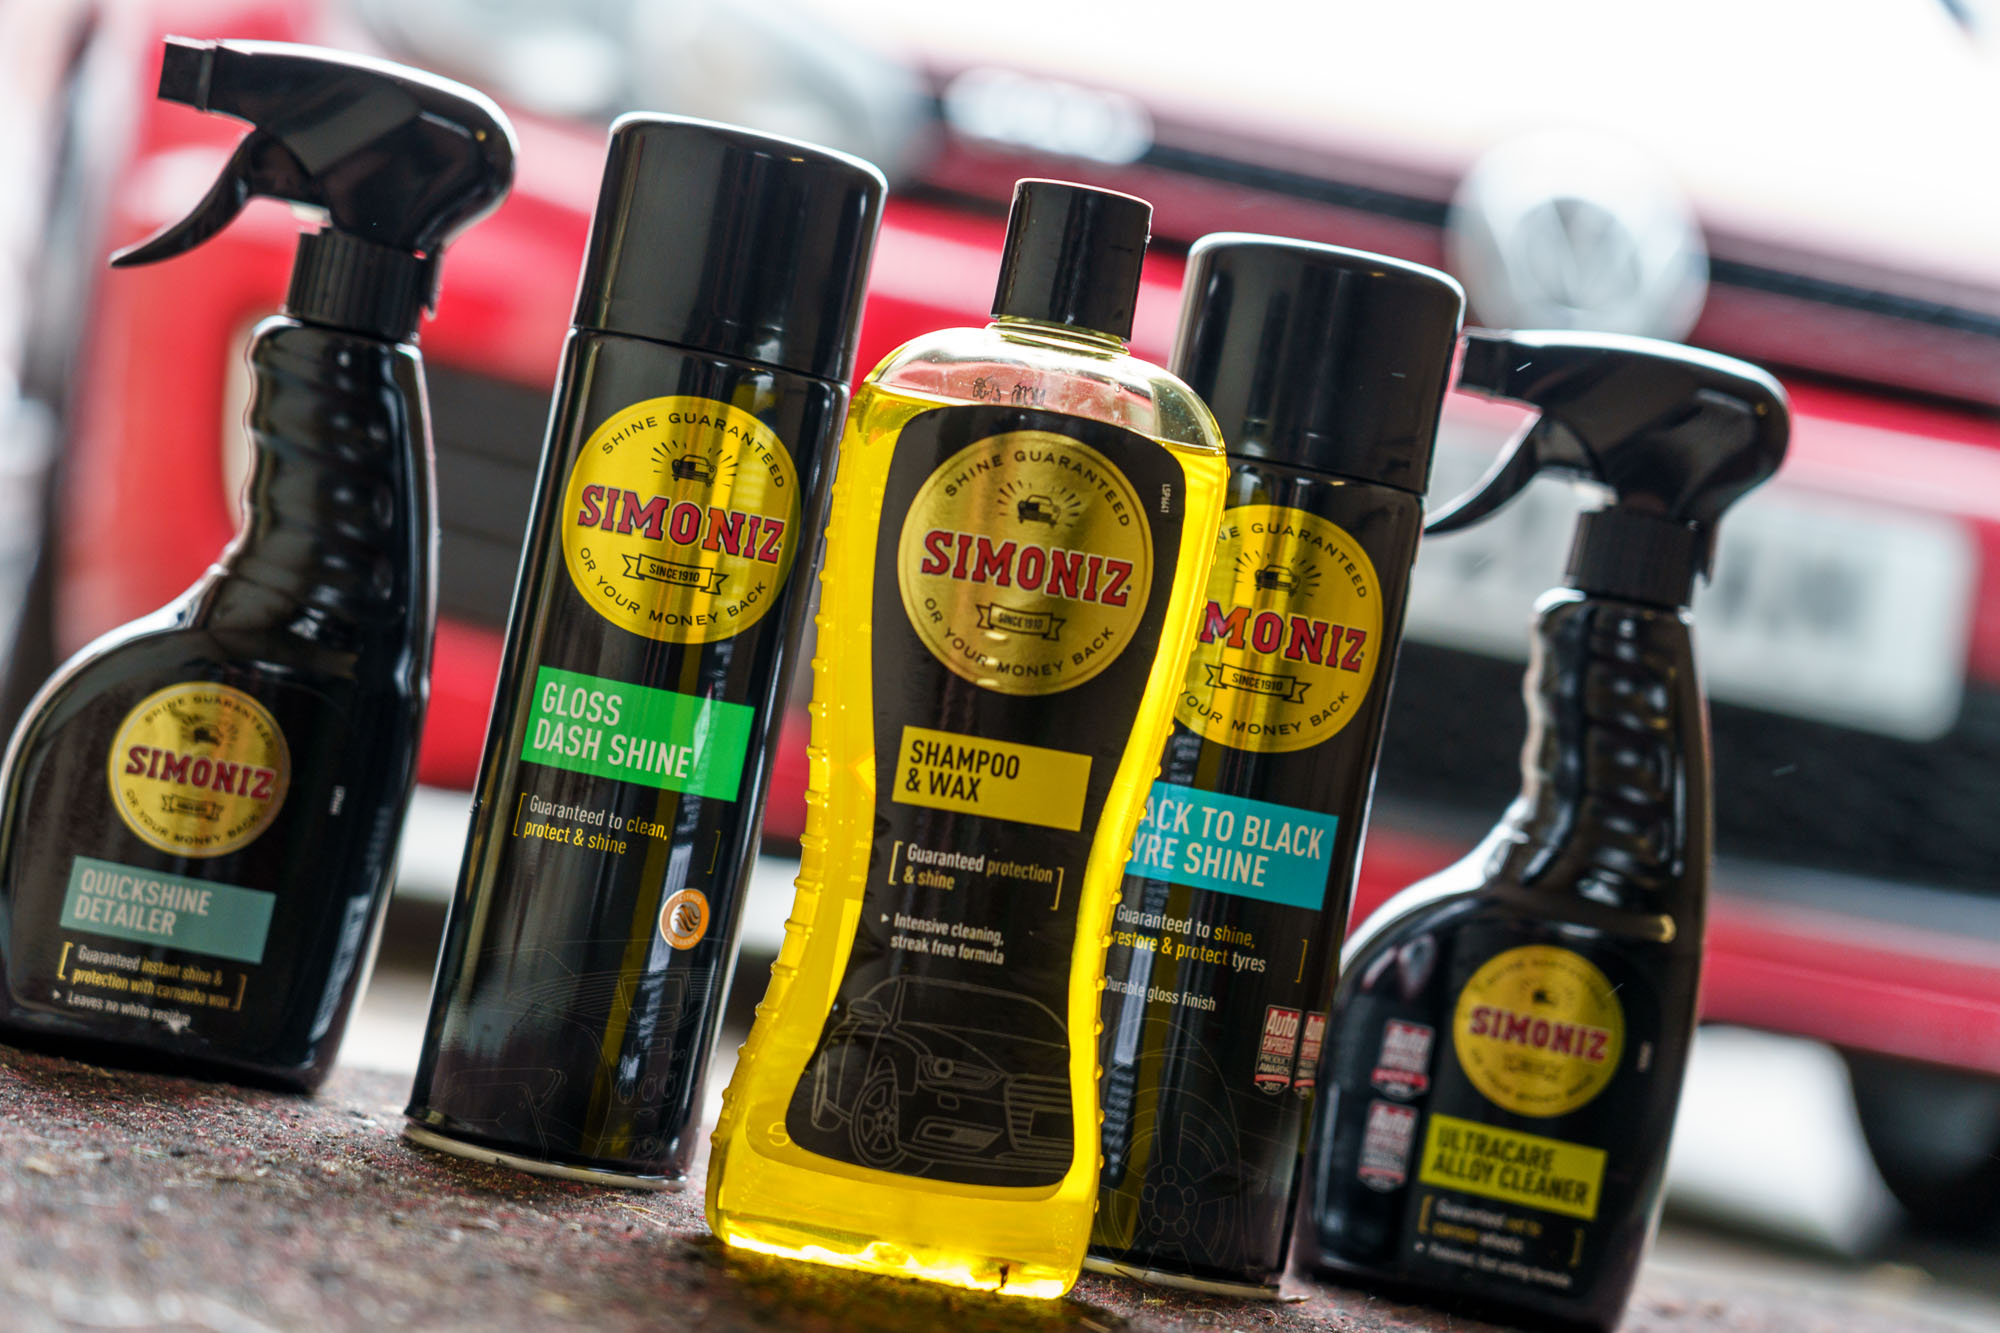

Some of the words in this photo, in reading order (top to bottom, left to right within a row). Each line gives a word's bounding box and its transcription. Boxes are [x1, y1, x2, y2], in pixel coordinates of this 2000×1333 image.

[602, 415, 658, 455] SHINE
[668, 412, 785, 488] GUARANTEED
[944, 454, 1004, 497] SHINE
[1014, 450, 1130, 527] GUARANTEED
[577, 483, 786, 564] SIMONIZ
[920, 530, 1134, 608] SIMONIZ
[1251, 522, 1366, 599] GUARANTEED
[580, 547, 596, 573] OR
[596, 576, 641, 615] YOUR
[649, 609, 718, 627] MONEY
[727, 582, 767, 617] BACK
[924, 597, 943, 625] OR
[945, 627, 989, 667] YOUR
[996, 656, 1064, 677] MONEY
[1073, 627, 1115, 666] BACK
[1199, 599, 1367, 673] MONIZ
[541, 681, 623, 727] GLOSS
[1181, 690, 1223, 724] YOUR
[1231, 720, 1302, 737] MONEY
[1310, 690, 1349, 727] BACK
[533, 718, 602, 761] DASH
[607, 733, 693, 779] SHINE
[910, 739, 1020, 780] SHAMPOO
[125, 745, 277, 800] SIMONIZ
[905, 767, 921, 793] &
[929, 770, 981, 803] WAX
[173, 833, 221, 846] MONEY
[523, 821, 570, 845] protect
[573, 829, 585, 846] &
[587, 834, 627, 855] shine
[529, 795, 605, 827] Guaranteed
[608, 812, 623, 830] to
[626, 816, 668, 841] clean,
[1144, 795, 1194, 835] ACK
[1201, 806, 1234, 842] TO
[1241, 815, 1324, 860] BLACK
[903, 865, 916, 884] &
[917, 871, 955, 891] shine
[907, 843, 984, 873] Guaranteed
[986, 857, 1053, 883] protection
[1132, 831, 1179, 869] YRE
[1184, 842, 1269, 888] SHINE
[79, 868, 213, 917] QUICKSHINE
[73, 896, 178, 937] DETAILER
[894, 912, 950, 936] Intensive
[950, 922, 1004, 947] cleaning,
[1117, 904, 1192, 935] Guaranteed
[1196, 921, 1210, 938] to
[1214, 924, 1256, 949] shine,
[78, 944, 141, 972] Guaranteed
[142, 959, 180, 979] instant
[182, 965, 212, 984] shine
[213, 970, 223, 987] &
[891, 934, 929, 954] streak
[932, 938, 956, 958] free
[958, 942, 1004, 966] formula
[1113, 930, 1158, 952] restore
[1161, 936, 1173, 955] &
[1175, 943, 1228, 966] protect
[1232, 952, 1266, 973] tyres
[67, 990, 104, 1009] Leaves
[105, 999, 120, 1013] no
[120, 1000, 150, 1018] white
[72, 968, 129, 991] protection
[130, 979, 155, 995] with
[156, 984, 207, 1005] carnauba
[208, 994, 230, 1009] wax
[1105, 975, 1145, 997] Durable
[1147, 986, 1179, 1005] gloss
[1181, 992, 1216, 1012] finish
[1265, 1010, 1299, 1038] Auto
[1470, 1004, 1611, 1064] SIMONIZ
[1437, 1126, 1554, 1172] ULTRACARE
[1433, 1153, 1495, 1185] ALLOY
[1498, 1164, 1590, 1207] CLEANER
